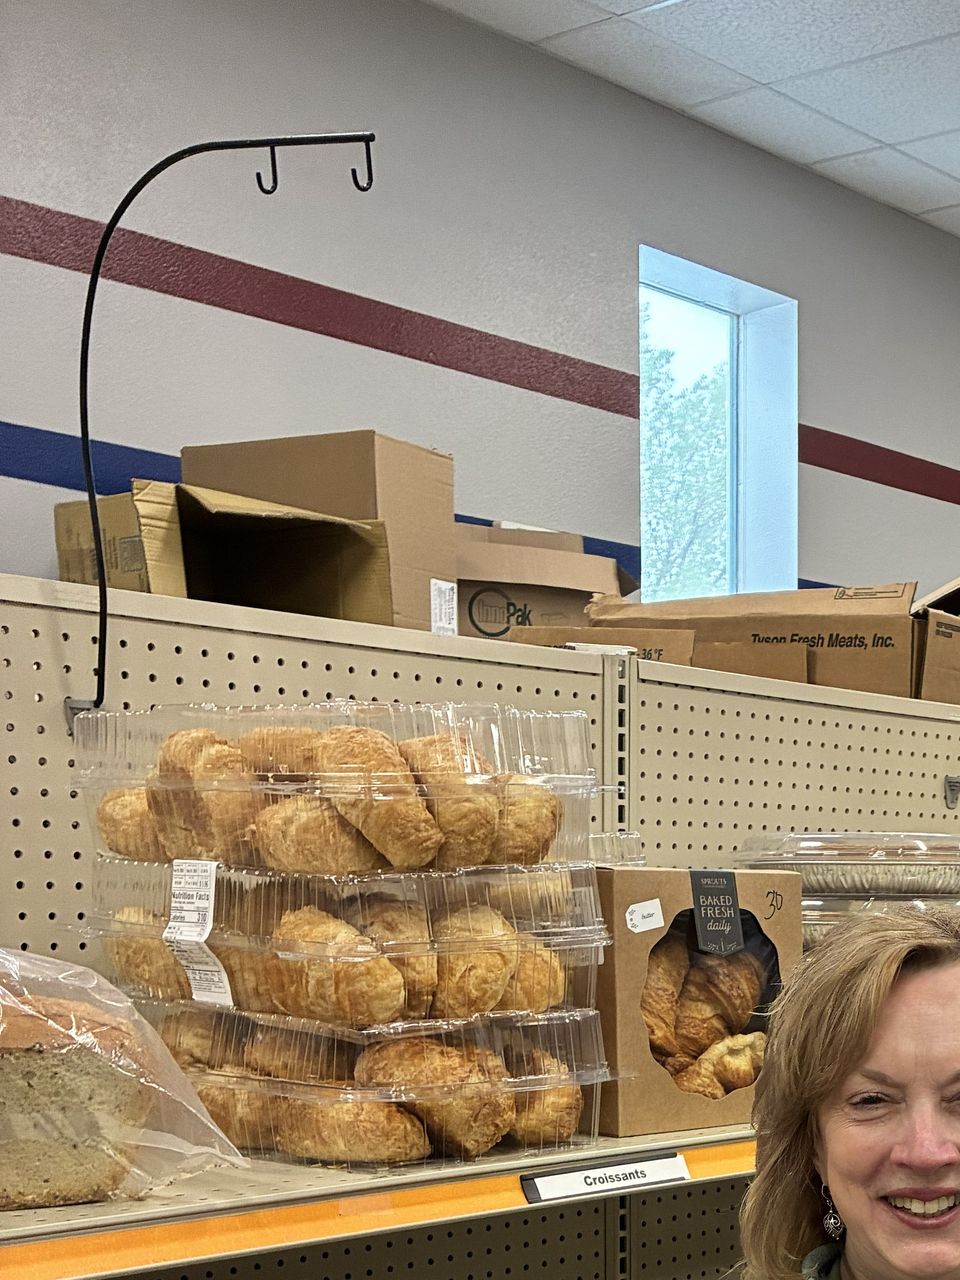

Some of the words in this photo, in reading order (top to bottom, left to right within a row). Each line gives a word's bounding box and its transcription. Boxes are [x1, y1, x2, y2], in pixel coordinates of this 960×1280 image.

[790, 633, 823, 648] Fresh
[827, 632, 868, 650] Meats,
[871, 633, 895, 648] Inc.
[172, 892, 194, 900] Nutrition
[195, 892, 209, 901] Facts
[700, 895, 732, 906] BAKED
[197, 912, 207, 922] 310
[641, 911, 655, 920] butter
[701, 907, 734, 918] FRESH
[707, 919, 731, 934] daily
[583, 1168, 647, 1187] Croissants
